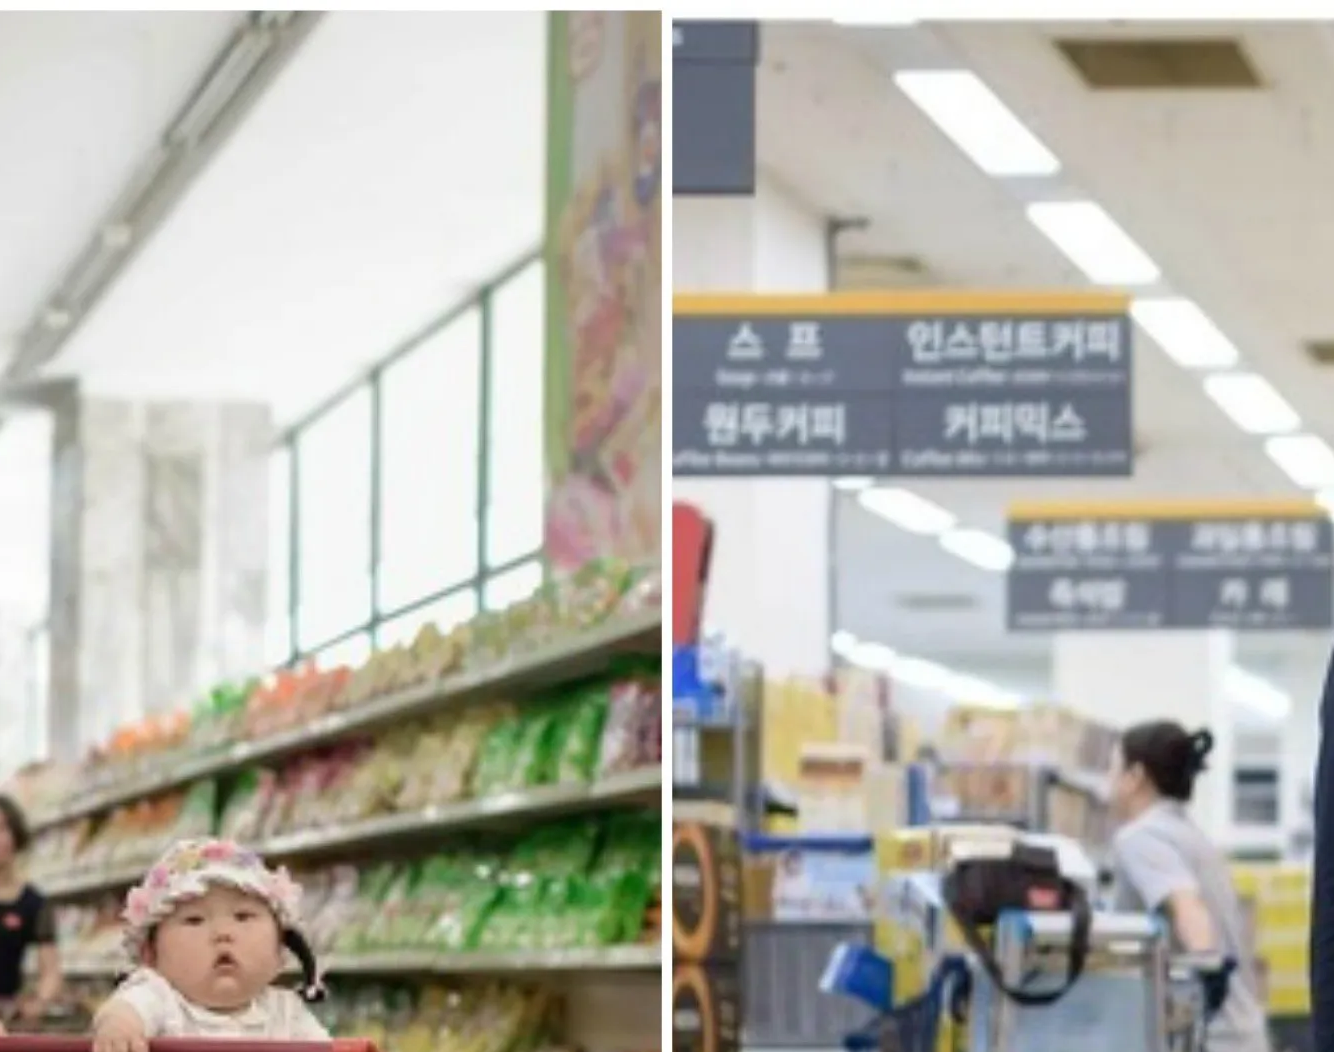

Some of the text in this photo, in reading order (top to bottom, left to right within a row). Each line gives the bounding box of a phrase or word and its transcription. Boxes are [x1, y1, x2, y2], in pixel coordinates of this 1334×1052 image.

[726, 320, 824, 360] 스 프
[906, 319, 1121, 364] 인스턴트커피
[703, 402, 846, 446] 원두커피
[943, 401, 1088, 444] 커피믹스
